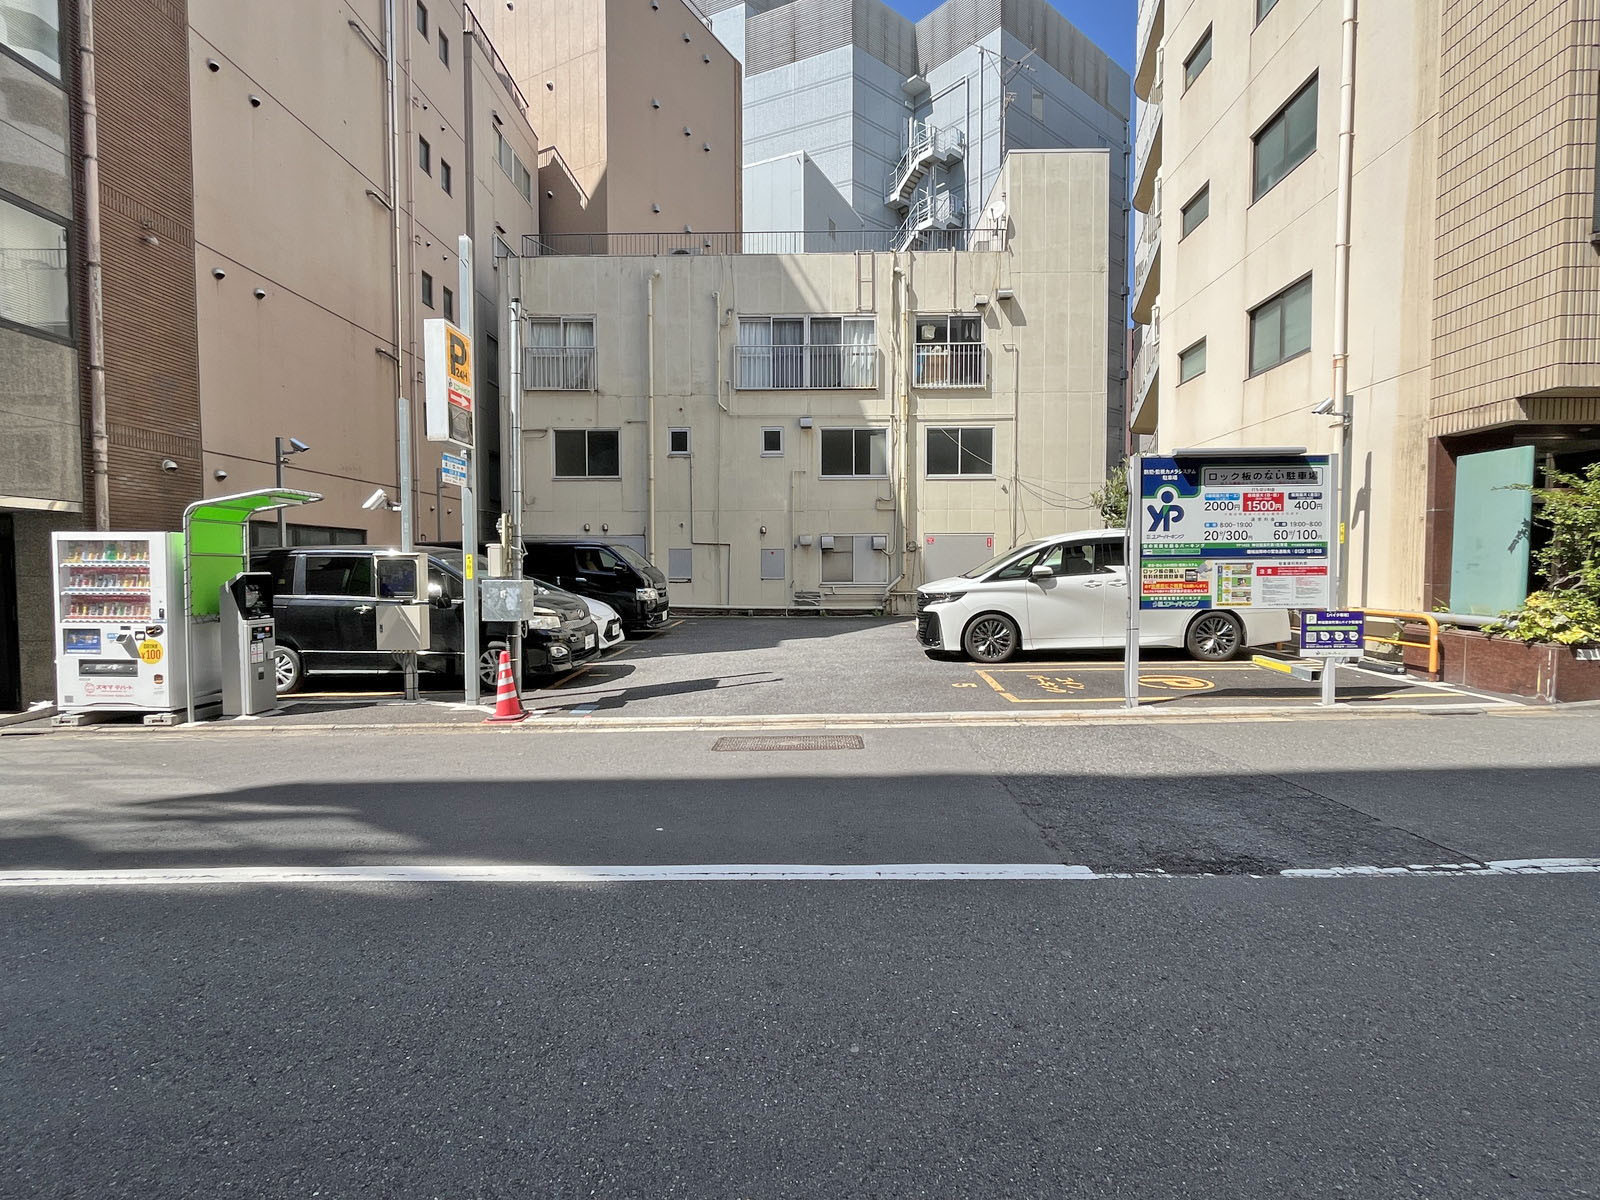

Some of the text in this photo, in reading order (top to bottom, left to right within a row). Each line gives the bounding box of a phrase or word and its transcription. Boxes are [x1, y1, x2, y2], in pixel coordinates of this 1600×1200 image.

[450, 332, 467, 376] P
[1208, 470, 1318, 481] ロック板のない駐車場
[1247, 501, 1282, 511] 1500円
